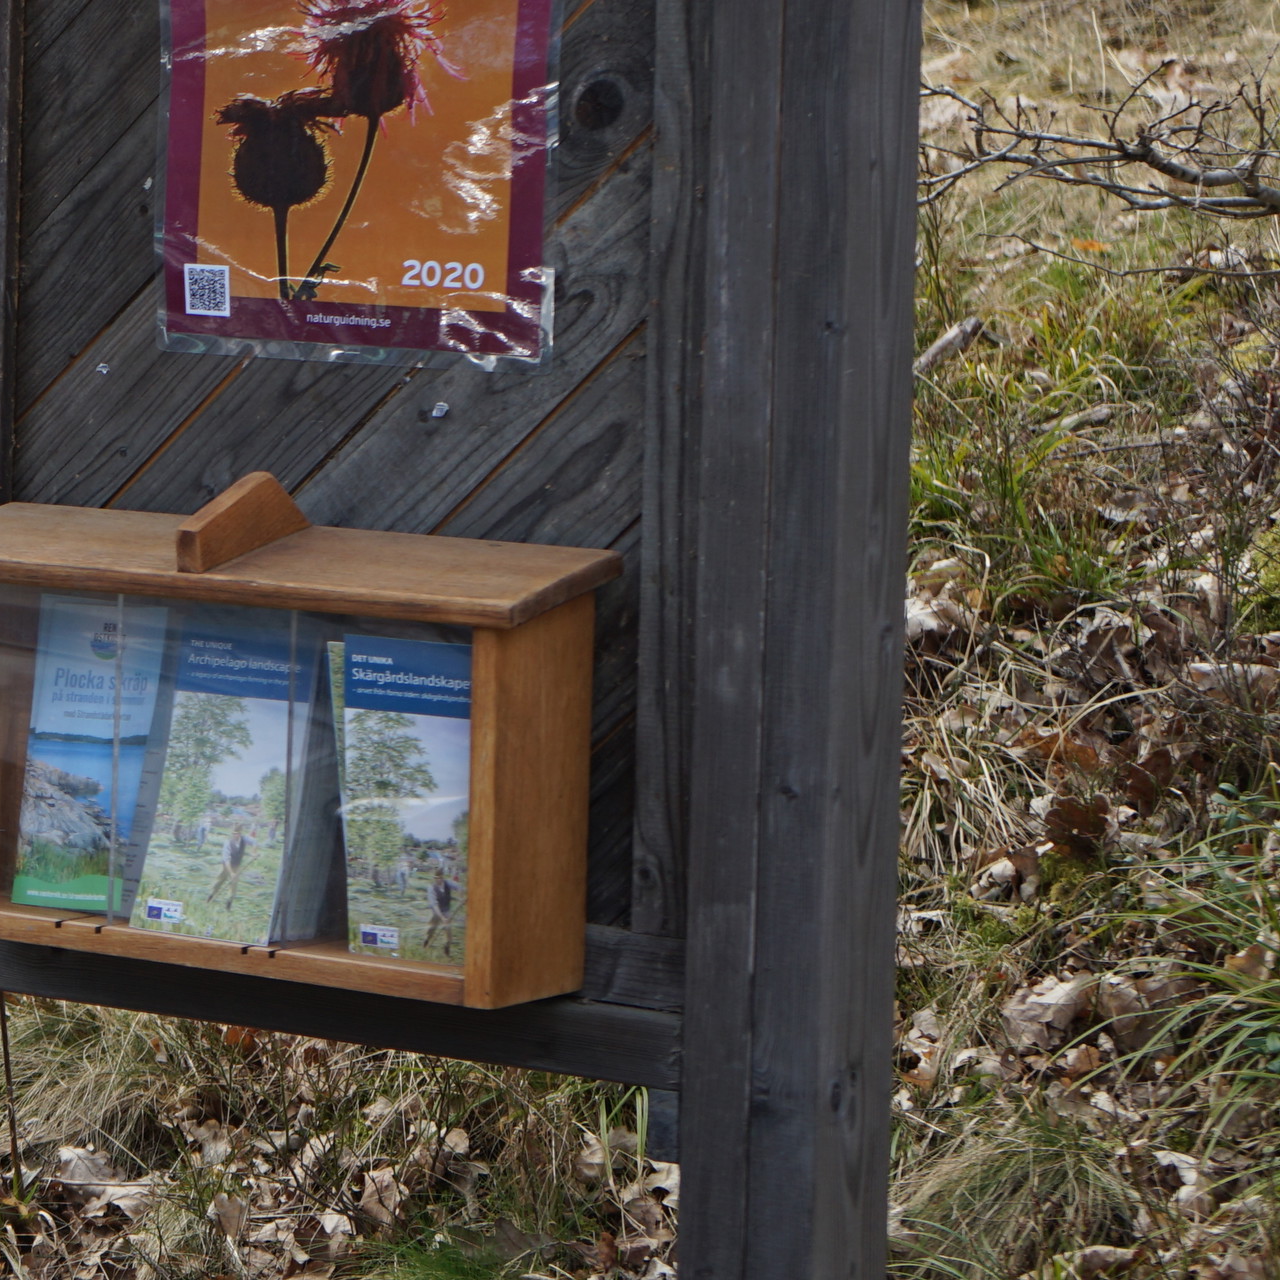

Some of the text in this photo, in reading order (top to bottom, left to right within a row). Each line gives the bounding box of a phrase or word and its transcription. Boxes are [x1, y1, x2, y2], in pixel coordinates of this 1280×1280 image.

[401, 259, 485, 289] 2020
[306, 313, 392, 329] naturguidning.se
[191, 639, 233, 650] THE UNIQUE
[188, 654, 247, 671] Archipelago
[351, 654, 367, 663] DET
[54, 667, 105, 690] Plocka
[352, 668, 472, 691] Skärgårdslandskape
[52, 690, 63, 703] på
[65, 690, 104, 704] stranden
